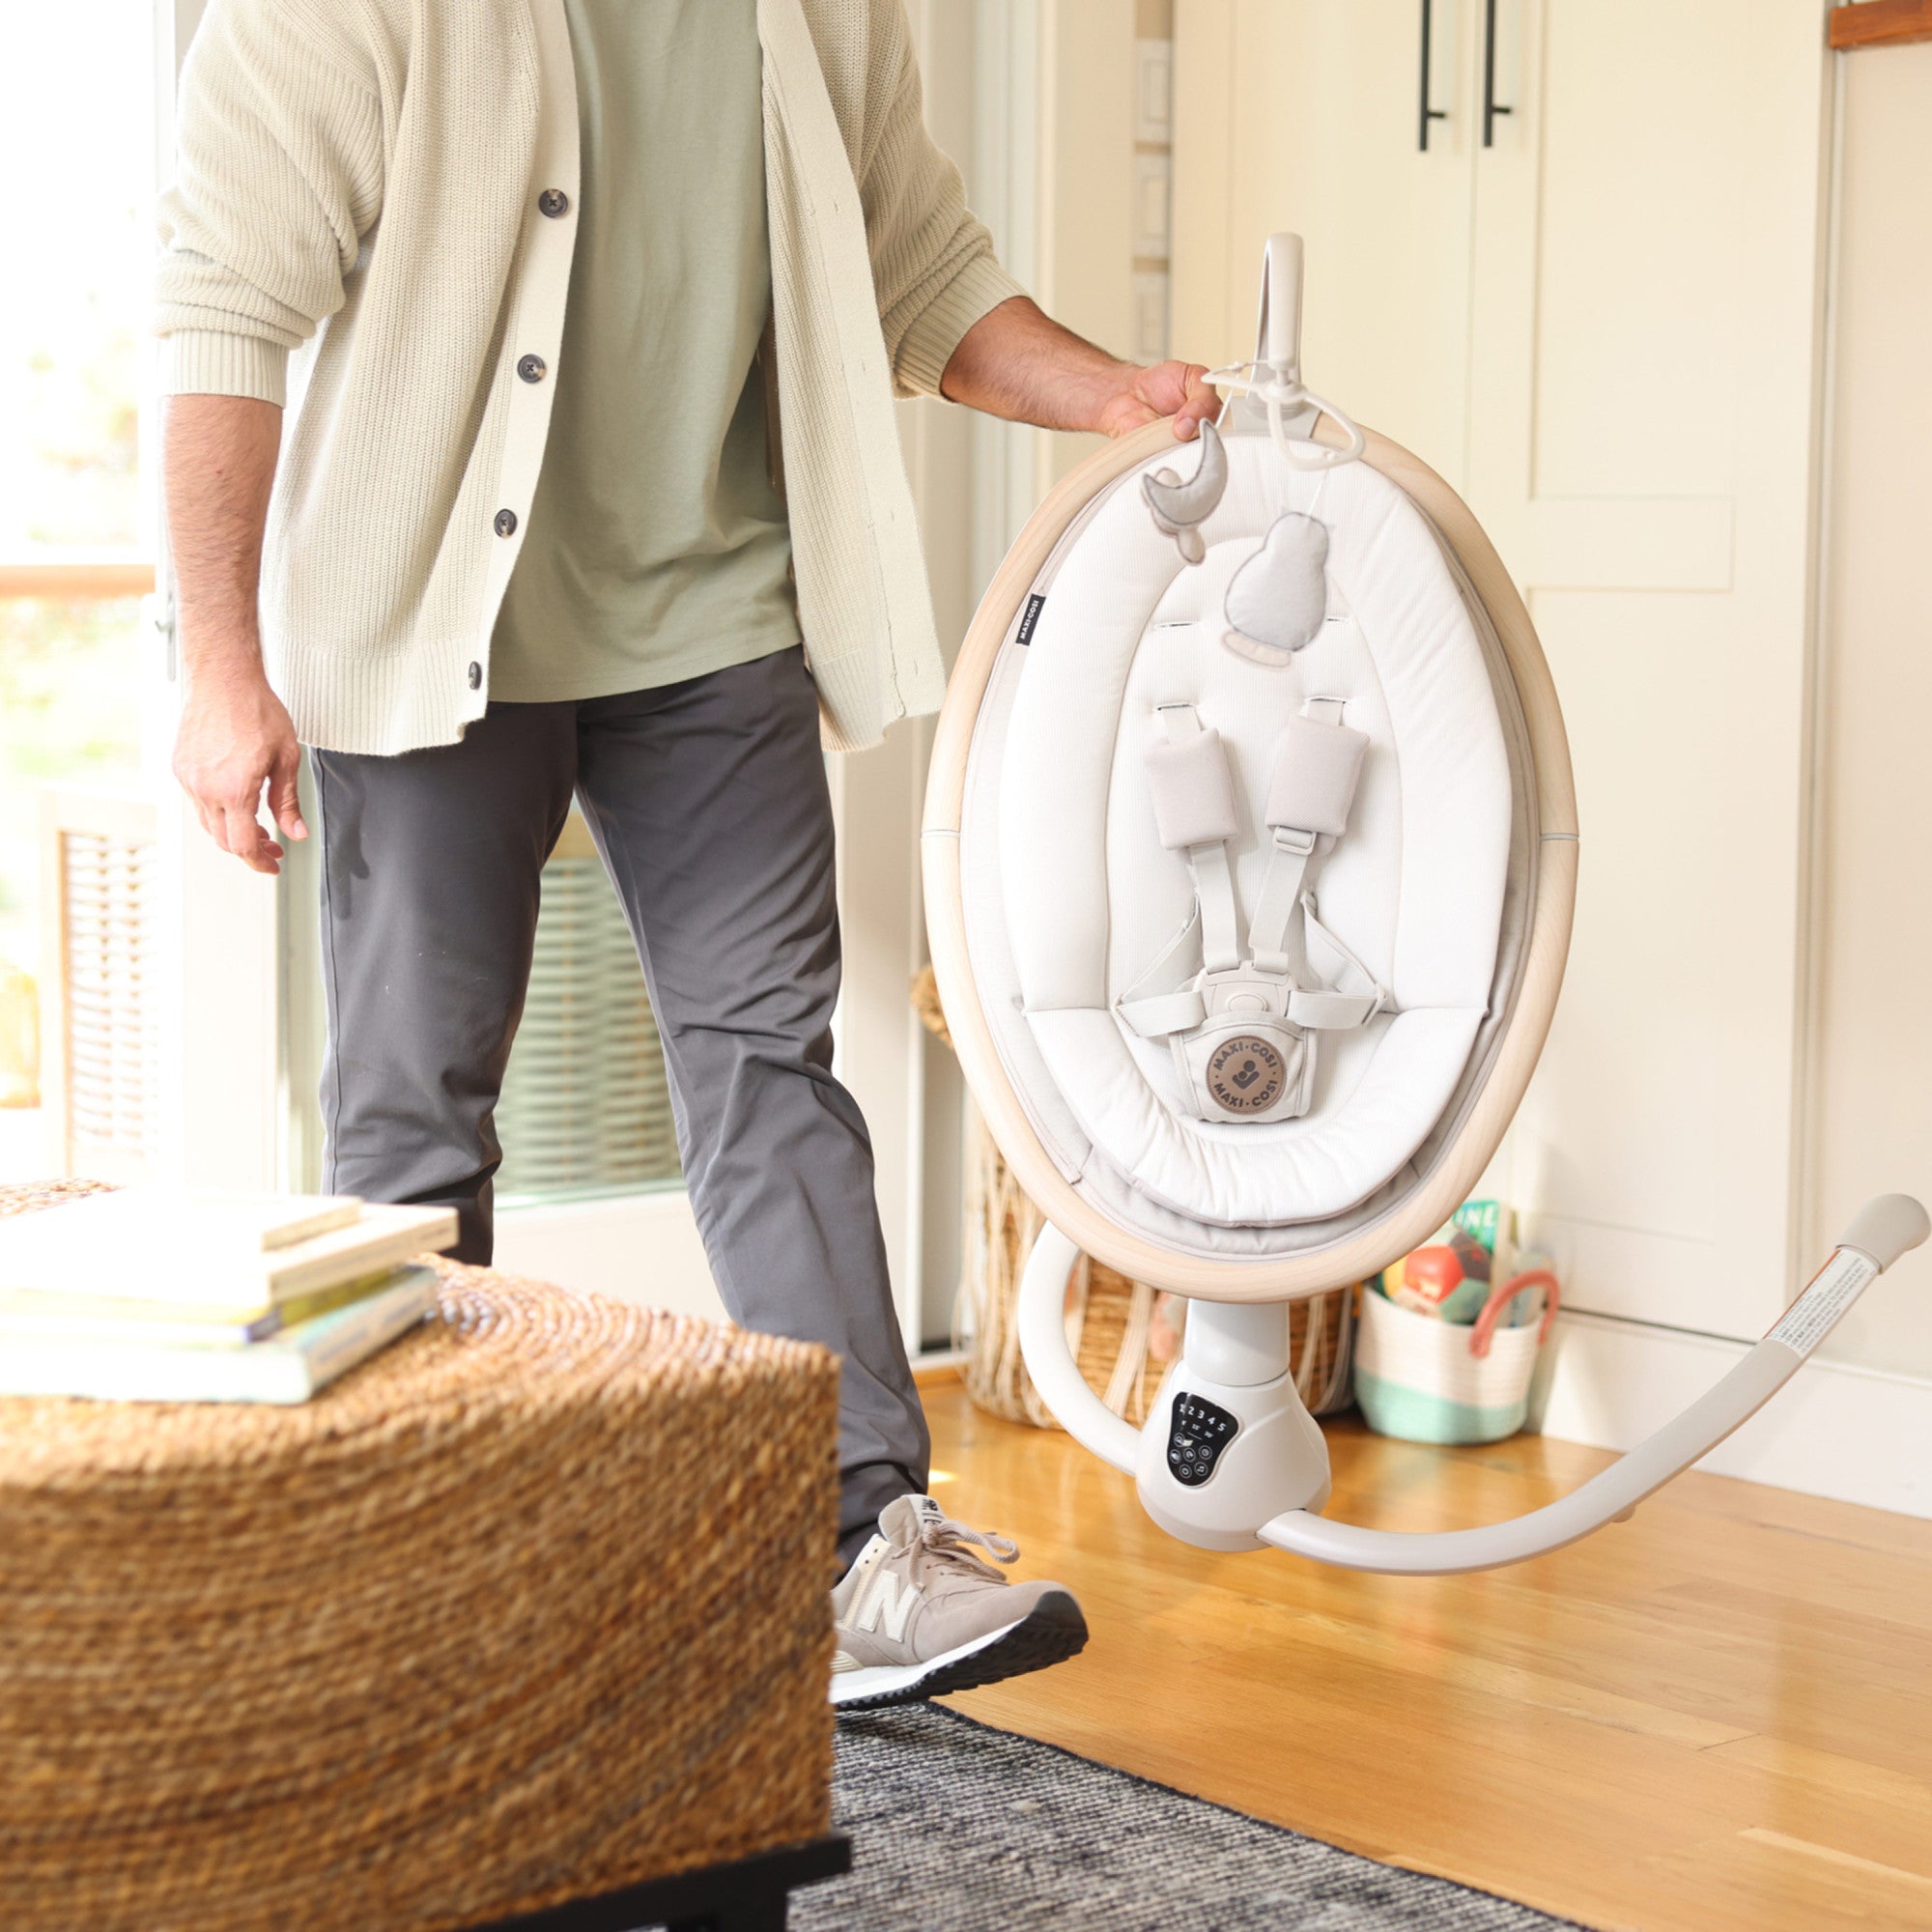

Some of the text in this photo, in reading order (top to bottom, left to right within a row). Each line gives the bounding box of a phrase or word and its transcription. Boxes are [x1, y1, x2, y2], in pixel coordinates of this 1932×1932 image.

[1187, 1406, 1195, 1415] 2
[1197, 1410, 1206, 1419] 3
[1208, 1416, 1216, 1425] 4
[1217, 1422, 1227, 1432] 5
[859, 1569, 919, 1642] N
